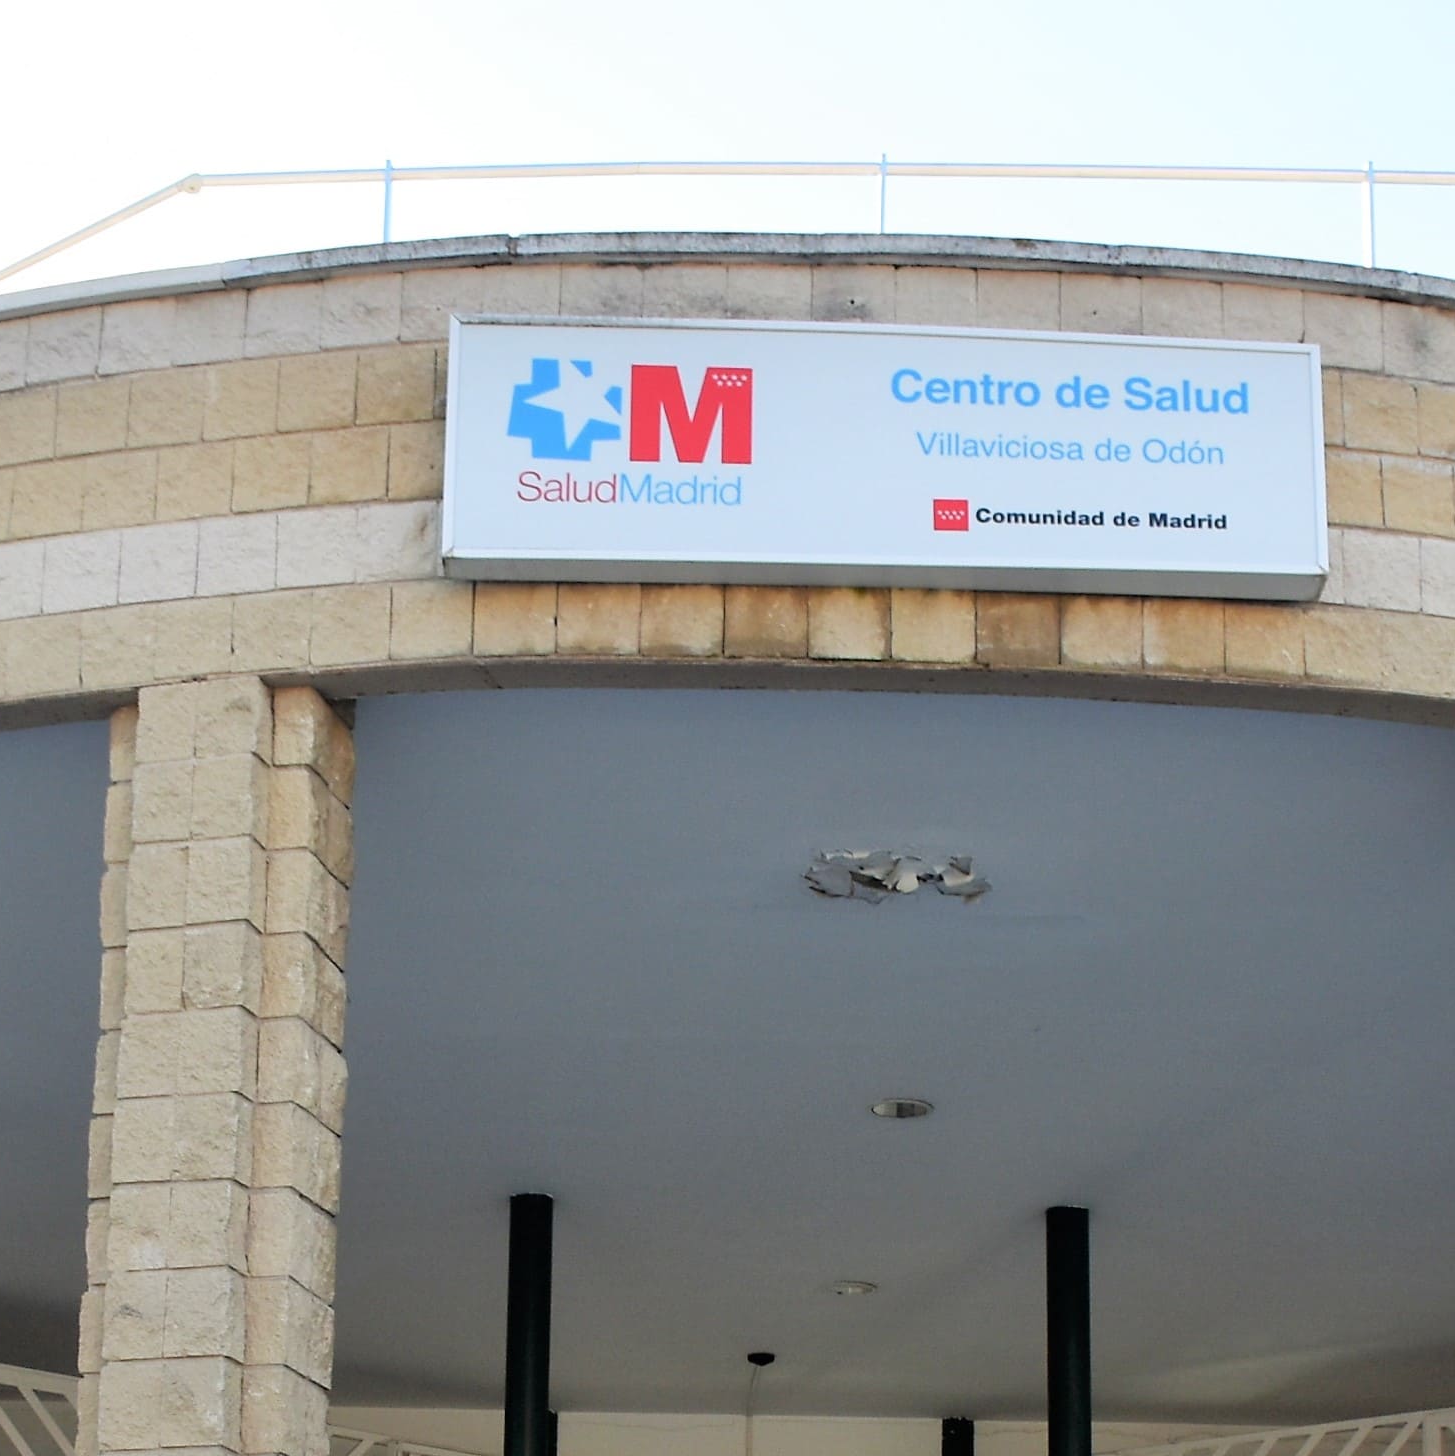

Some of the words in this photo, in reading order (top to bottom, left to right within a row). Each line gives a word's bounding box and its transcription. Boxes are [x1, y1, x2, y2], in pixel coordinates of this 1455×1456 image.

[890, 367, 1043, 408] Centro
[1054, 375, 1112, 410] de
[1123, 376, 1251, 415] Salud
[628, 363, 754, 466] M
[916, 431, 1085, 462] Villaviciosa
[1094, 438, 1133, 463] de
[1142, 438, 1225, 466] Odón
[516, 470, 743, 507] SaludMadrid
[975, 507, 1105, 527] Comunidad
[1112, 511, 1141, 528] de
[1148, 512, 1229, 530] Madrid
